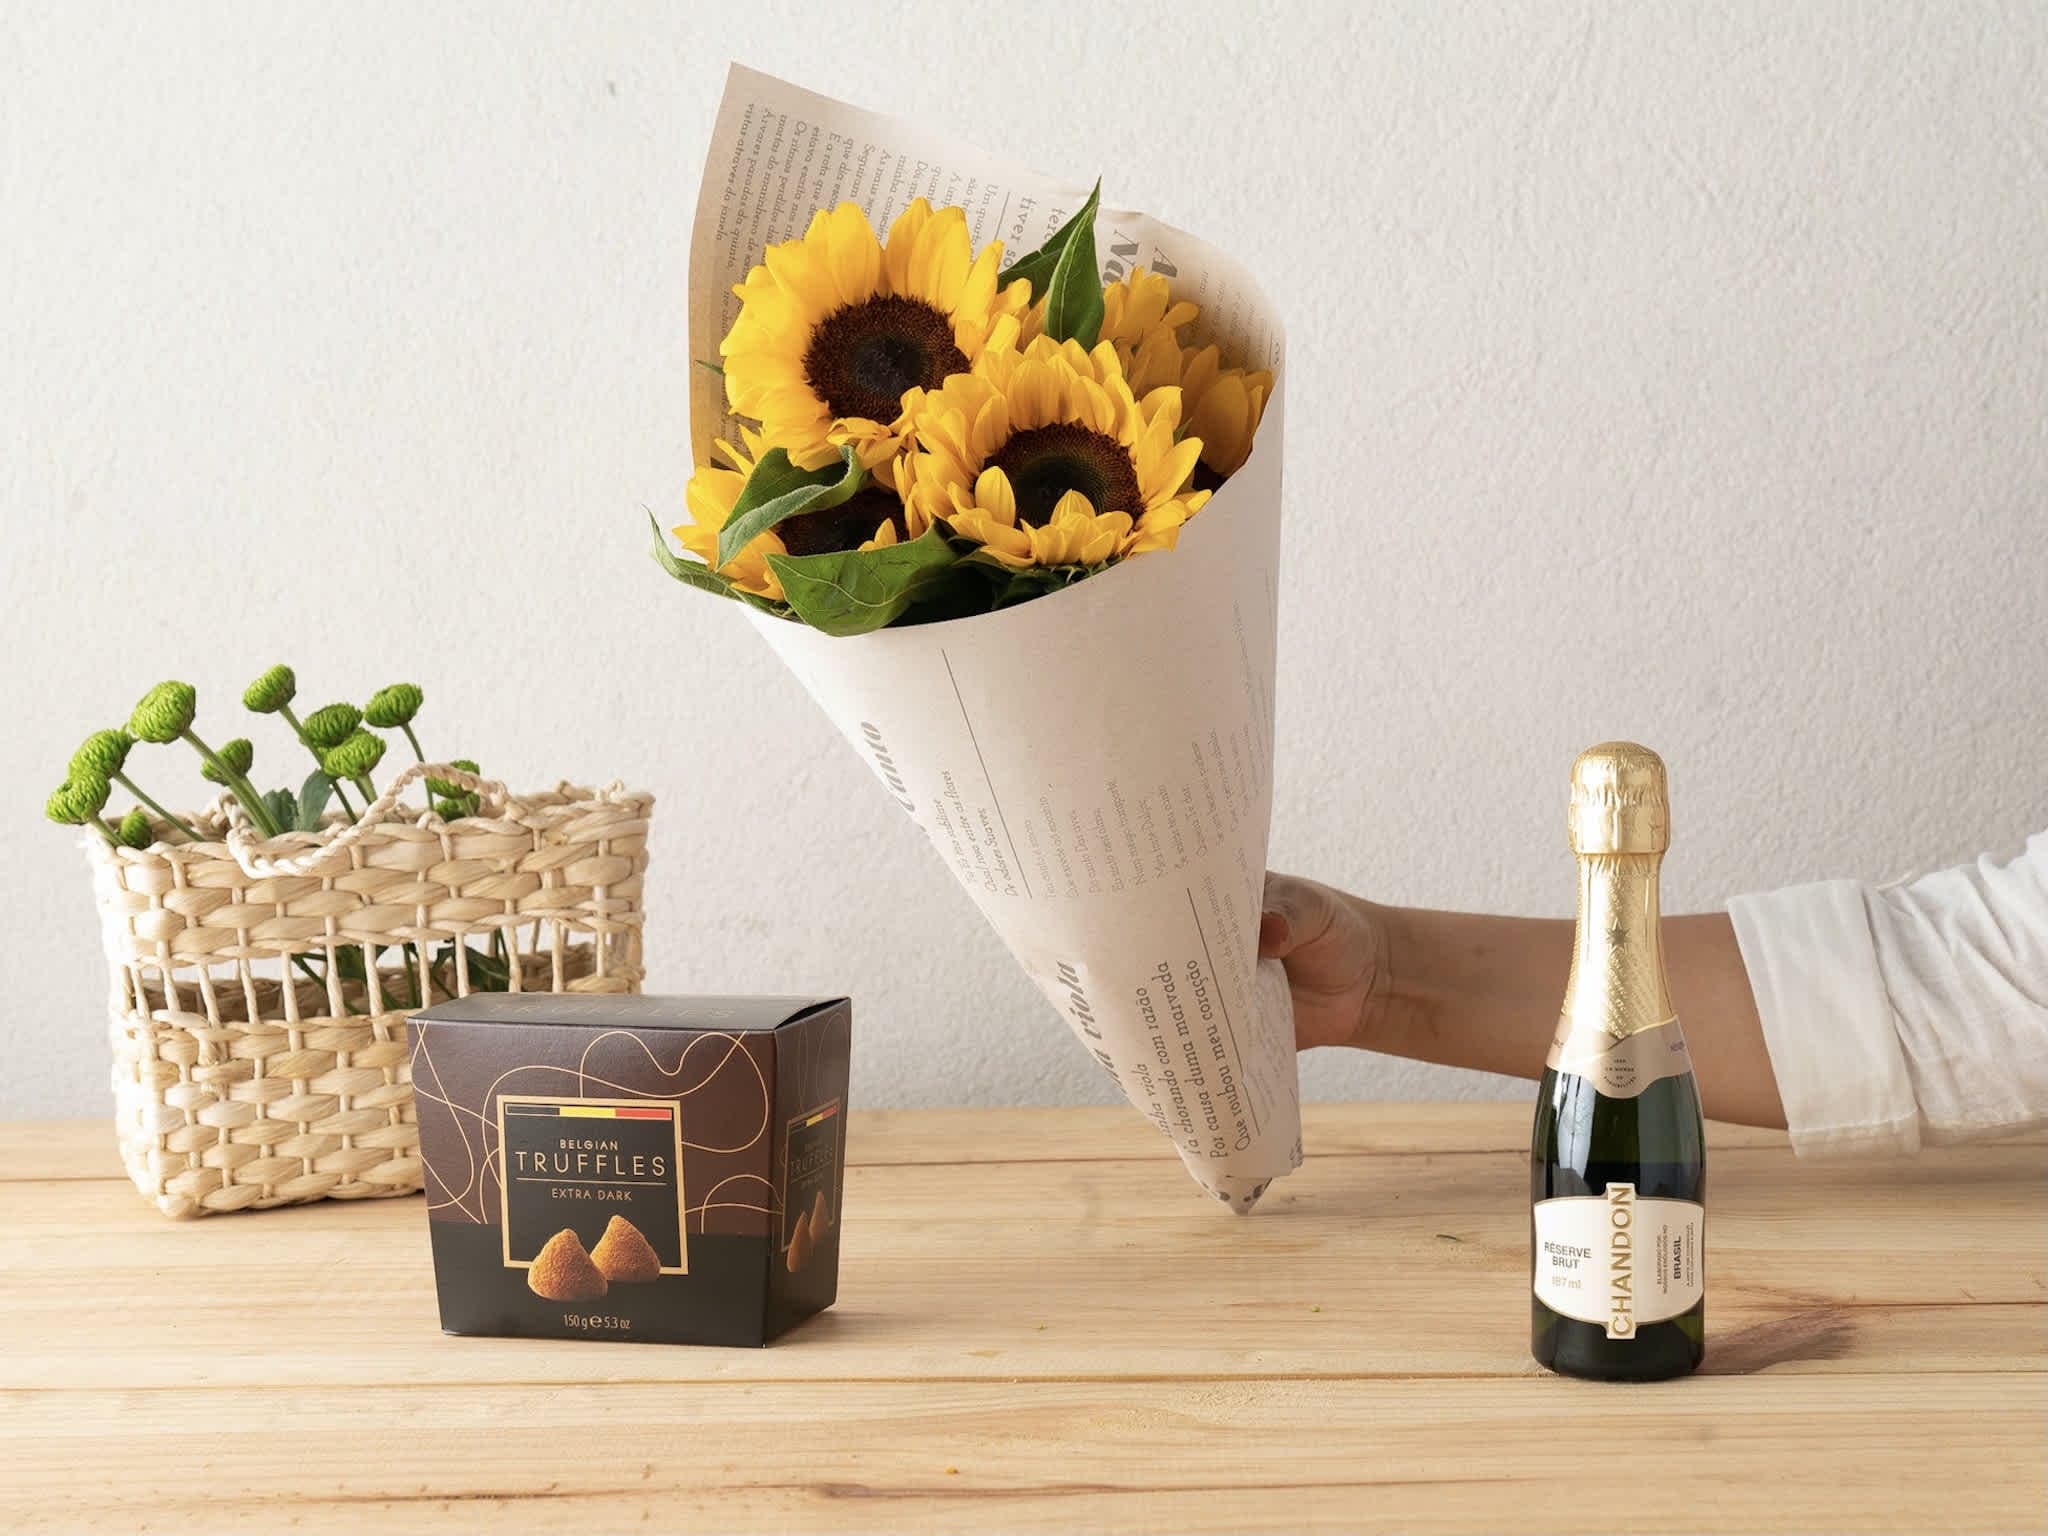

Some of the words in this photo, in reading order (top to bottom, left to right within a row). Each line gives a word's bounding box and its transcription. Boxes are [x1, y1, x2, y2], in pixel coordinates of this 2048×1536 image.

[740, 103, 754, 135] vistas
[771, 114, 787, 152] mortas
[794, 121, 807, 136] Os
[805, 127, 819, 162] estava
[842, 138, 853, 159] que
[767, 155, 778, 170] do
[819, 154, 830, 176] rota
[836, 162, 850, 180] dia
[850, 144, 874, 197] Seguiram
[890, 155, 905, 192] minha
[724, 186, 736, 201] da
[741, 158, 756, 206] paradas
[812, 180, 823, 200] que
[751, 172, 770, 234] marinheiro
[771, 176, 787, 222] perdidos
[735, 209, 747, 224] da
[747, 238, 759, 251] de
[942, 771, 958, 798] flores
[959, 816, 976, 841] entre
[1152, 962, 1189, 1036] marvada
[1186, 960, 1212, 1020] coração
[1136, 987, 1158, 1029] razão
[1152, 1035, 1170, 1064] com
[1207, 1024, 1225, 1060] meu
[1183, 1041, 1204, 1086] duma
[1132, 1064, 1155, 1096] viola
[1217, 1065, 1241, 1116] roubou
[1158, 1070, 1193, 1133] chorando
[1199, 1091, 1219, 1131] causa
[559, 1139, 618, 1151] BELGIAN
[1209, 1137, 1228, 1158] Por
[1234, 1119, 1251, 1151] Que
[515, 1151, 665, 1176] TRUFFLES
[551, 1187, 591, 1200] EXTRA
[598, 1190, 633, 1201] DARK
[1552, 1256, 1580, 1269] BRUT
[1611, 1187, 1632, 1336] CHANDON
[620, 1319, 631, 1329] oz
